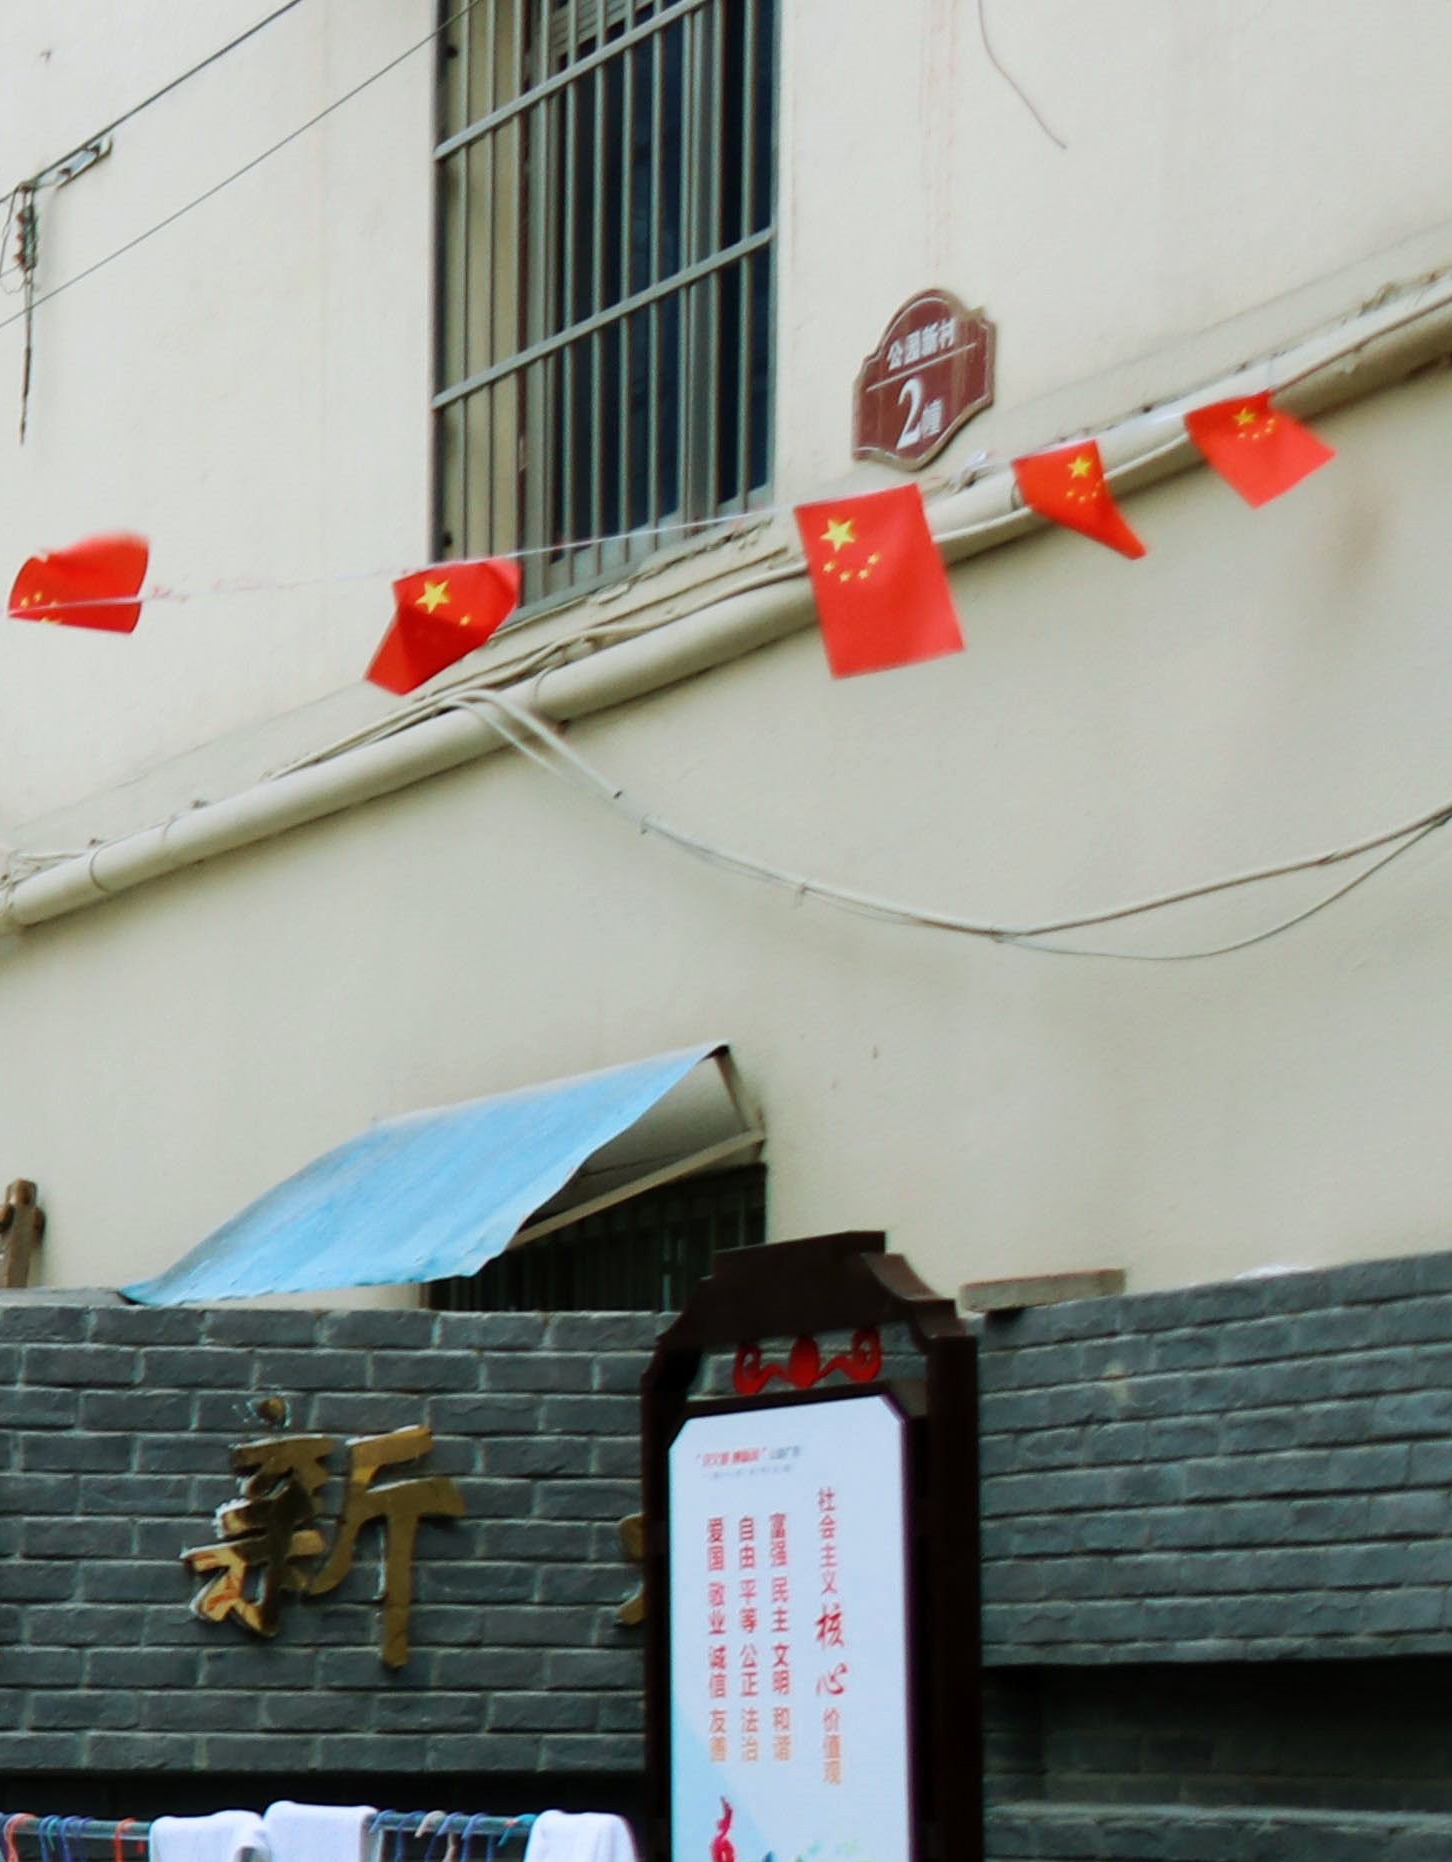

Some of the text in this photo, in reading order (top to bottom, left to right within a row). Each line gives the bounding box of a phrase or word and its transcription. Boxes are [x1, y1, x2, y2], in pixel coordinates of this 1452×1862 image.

[707, 1517, 728, 1763] 爱国 敬业 诚信 友善
[738, 1516, 759, 1762] 自由 平等 公正 法治
[769, 1512, 791, 1761] 富强 民主 文明 和谐
[814, 1487, 849, 1785] 社会主义核心价值观
